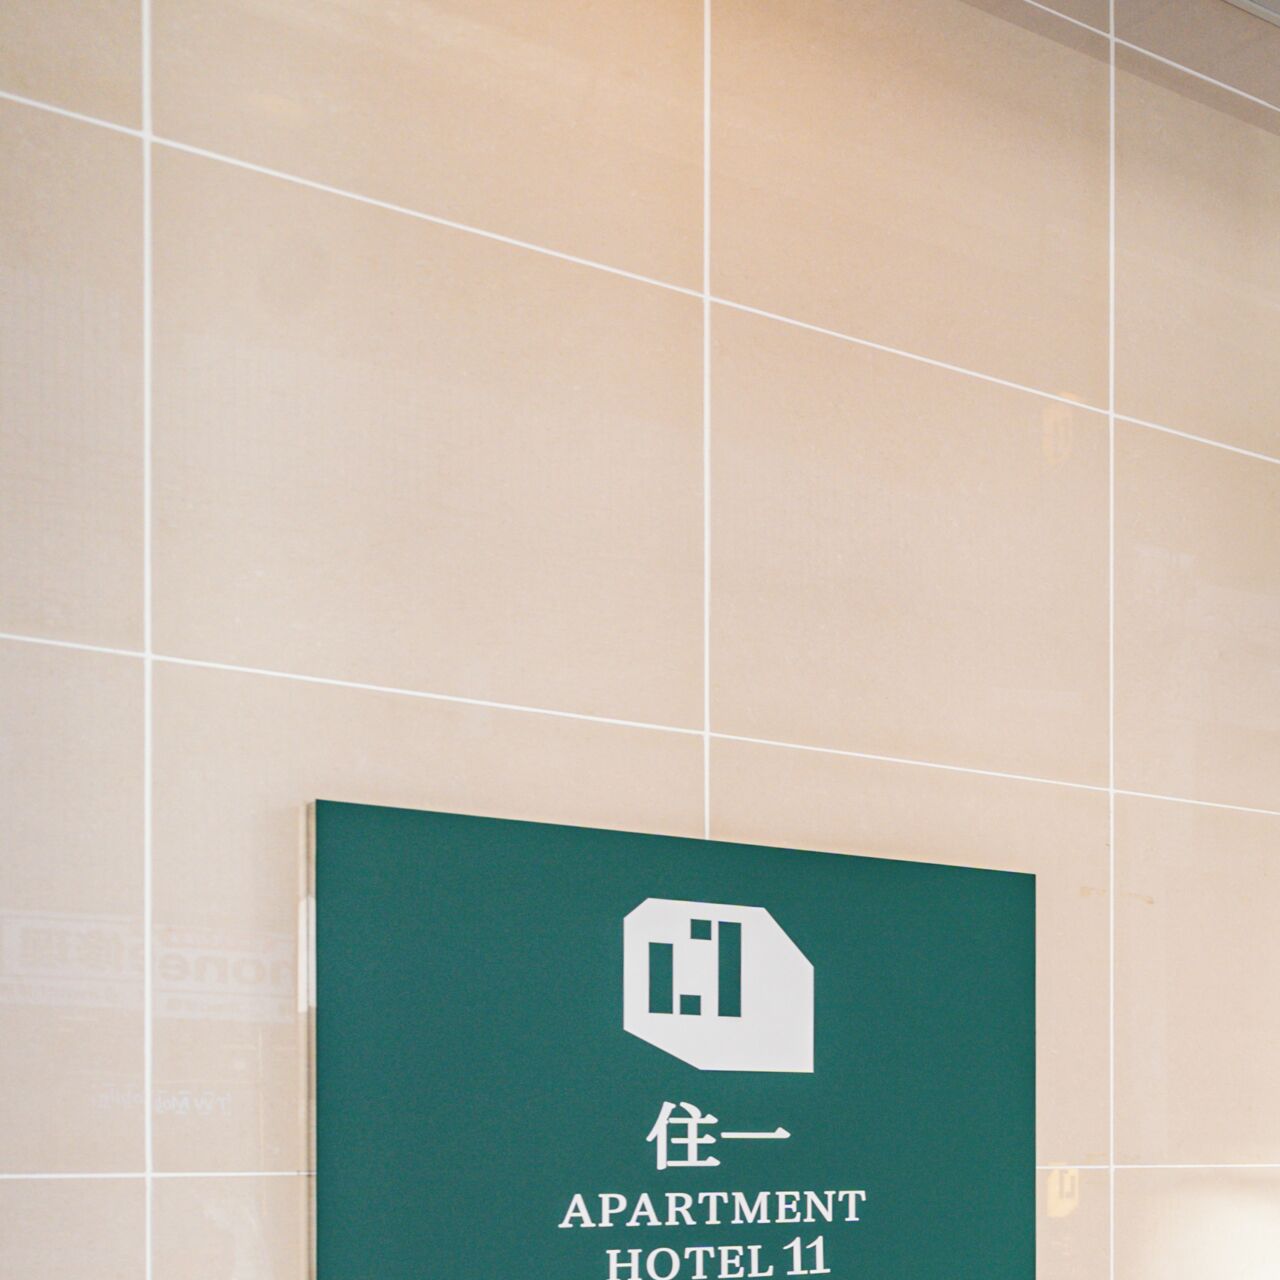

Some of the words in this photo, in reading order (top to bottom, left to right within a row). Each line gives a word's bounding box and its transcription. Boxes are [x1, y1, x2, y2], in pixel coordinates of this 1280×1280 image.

[646, 1102, 790, 1171] 住一
[557, 1190, 867, 1229] APARTMENT
[783, 1236, 831, 1276] 11
